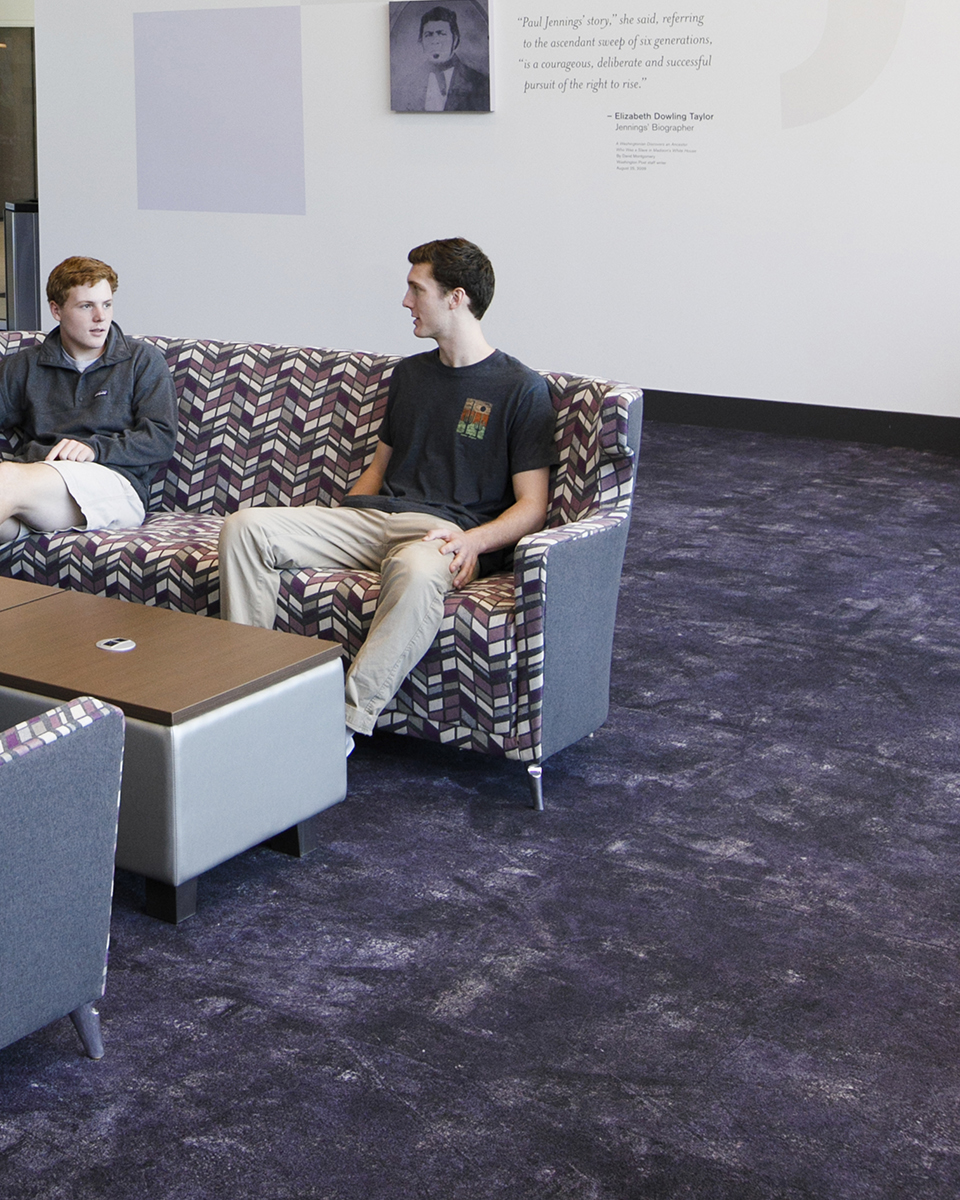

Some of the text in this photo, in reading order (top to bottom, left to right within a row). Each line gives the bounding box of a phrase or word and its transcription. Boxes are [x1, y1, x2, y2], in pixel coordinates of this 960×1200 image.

[518, 12, 704, 30] “Paul Jennings’ story,” she said, referring
[523, 35, 712, 50] to the ascendant sweep of six generations,
[519, 59, 530, 69] “is
[541, 61, 593, 72] courageous,
[597, 57, 642, 68] deliberate
[645, 56, 664, 67] and
[666, 55, 712, 70] successful
[524, 77, 647, 93] pursuit of the right to rise.”
[615, 112, 651, 120] Elizabeth
[654, 112, 687, 121] Dowling
[690, 112, 714, 121] Taylor
[615, 123, 694, 133] Jennings’ Biographer
